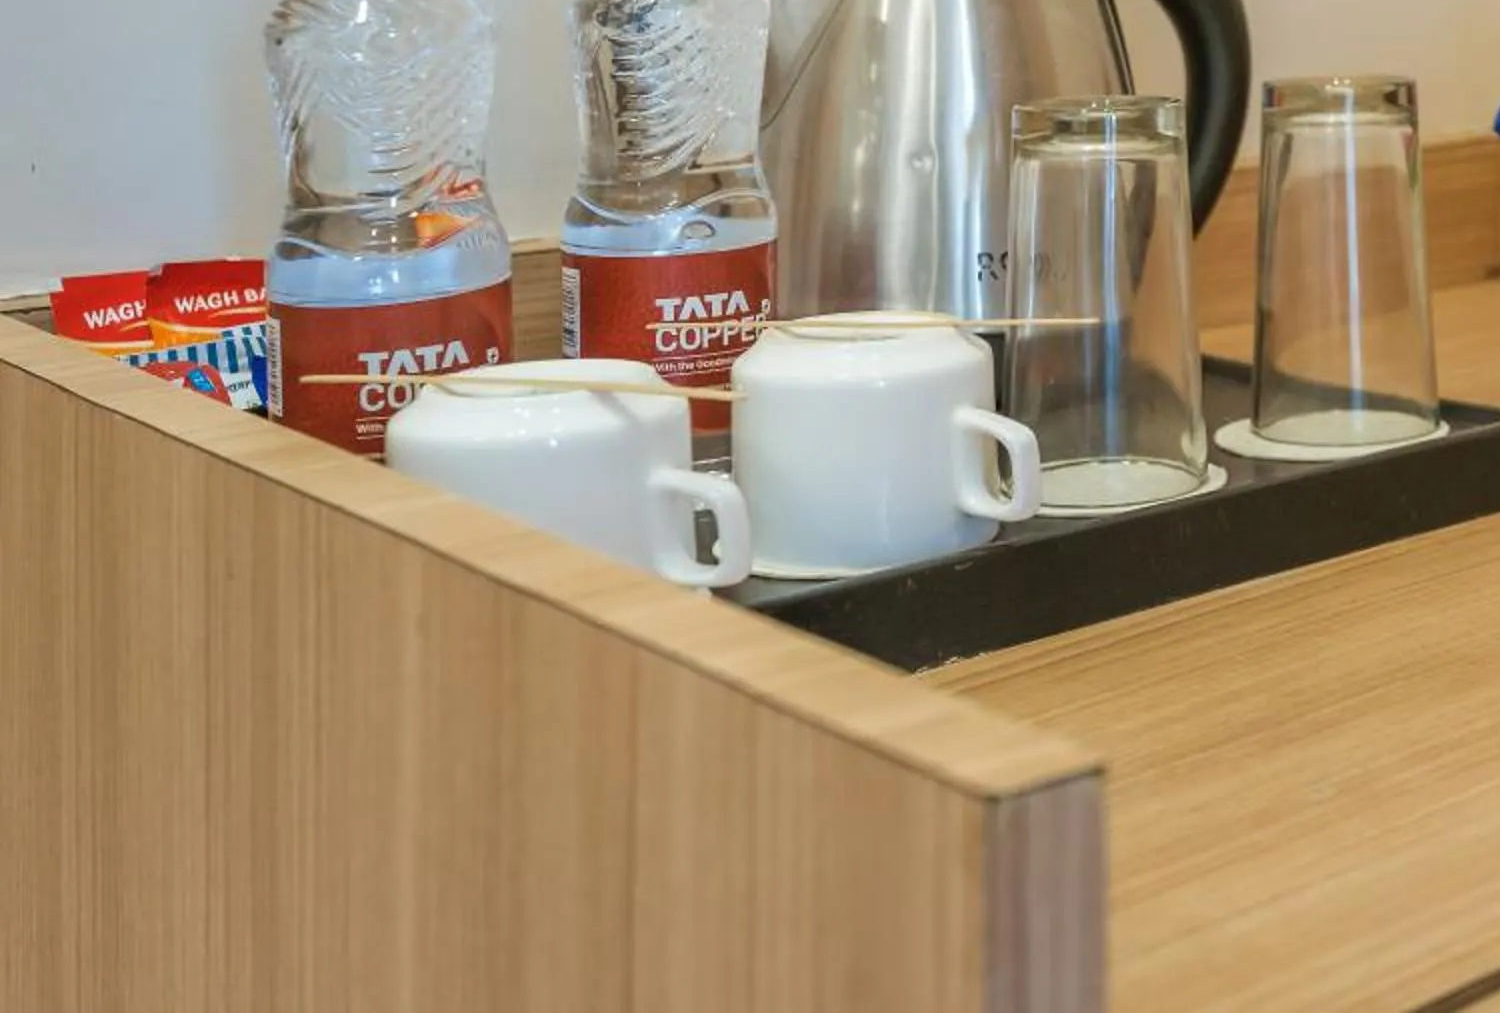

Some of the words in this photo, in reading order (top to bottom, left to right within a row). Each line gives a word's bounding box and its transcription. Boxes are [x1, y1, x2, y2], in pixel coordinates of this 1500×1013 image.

[175, 291, 240, 315] WAGH
[655, 290, 751, 322] TATA
[357, 340, 470, 380] TATA
